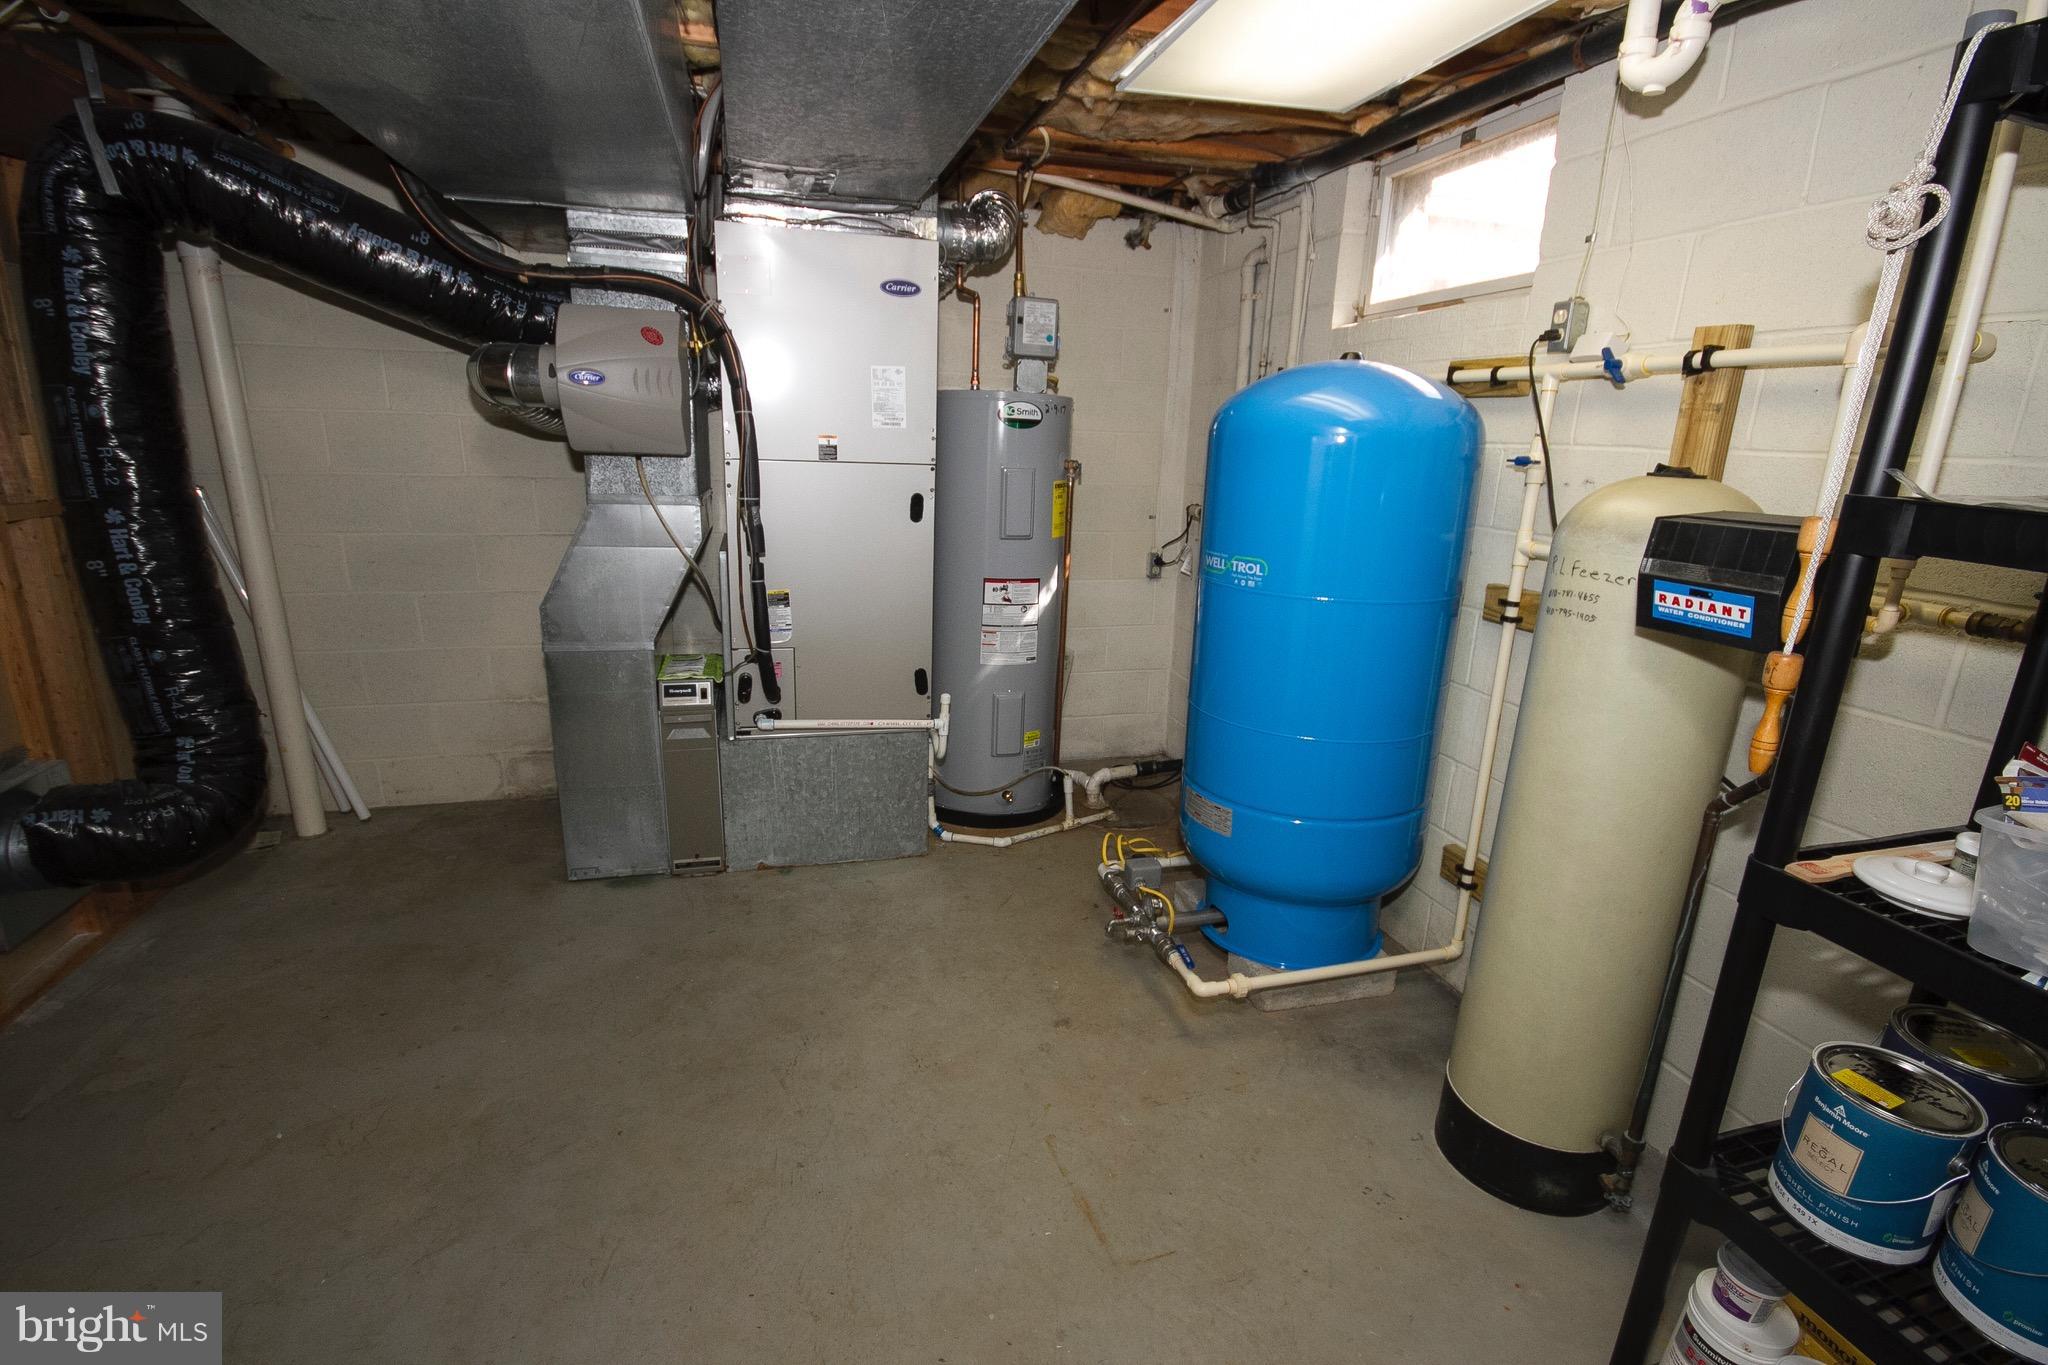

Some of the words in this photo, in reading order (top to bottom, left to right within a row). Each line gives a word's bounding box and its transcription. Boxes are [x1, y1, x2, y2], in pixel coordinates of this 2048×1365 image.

[63, 266, 84, 301] Hart
[886, 282, 917, 293] Carrier
[68, 320, 92, 377] Cooley
[573, 371, 601, 382] Carrier
[1016, 407, 1039, 417] Smith
[109, 529, 135, 561] Hart
[117, 562, 139, 576] &
[1205, 554, 1226, 570] WELL
[1230, 560, 1263, 576] TROL
[1570, 559, 1636, 587] Feezer
[123, 577, 152, 626] Cooley
[1658, 593, 1747, 620] RADIANT
[1657, 605, 1684, 617] WATER
[1687, 611, 1746, 629] CONDITIONER
[2004, 794, 2021, 807] 20
[1813, 1095, 1842, 1121] Benjamin
[1842, 1118, 1868, 1138] Moore
[1802, 1134, 1848, 1174] REGAL
[1982, 1173, 2001, 1196] Moore
[1818, 1202, 1860, 1229] FINISH
[1951, 1261, 1981, 1295] FINISH
[2012, 1318, 2044, 1338] promise
